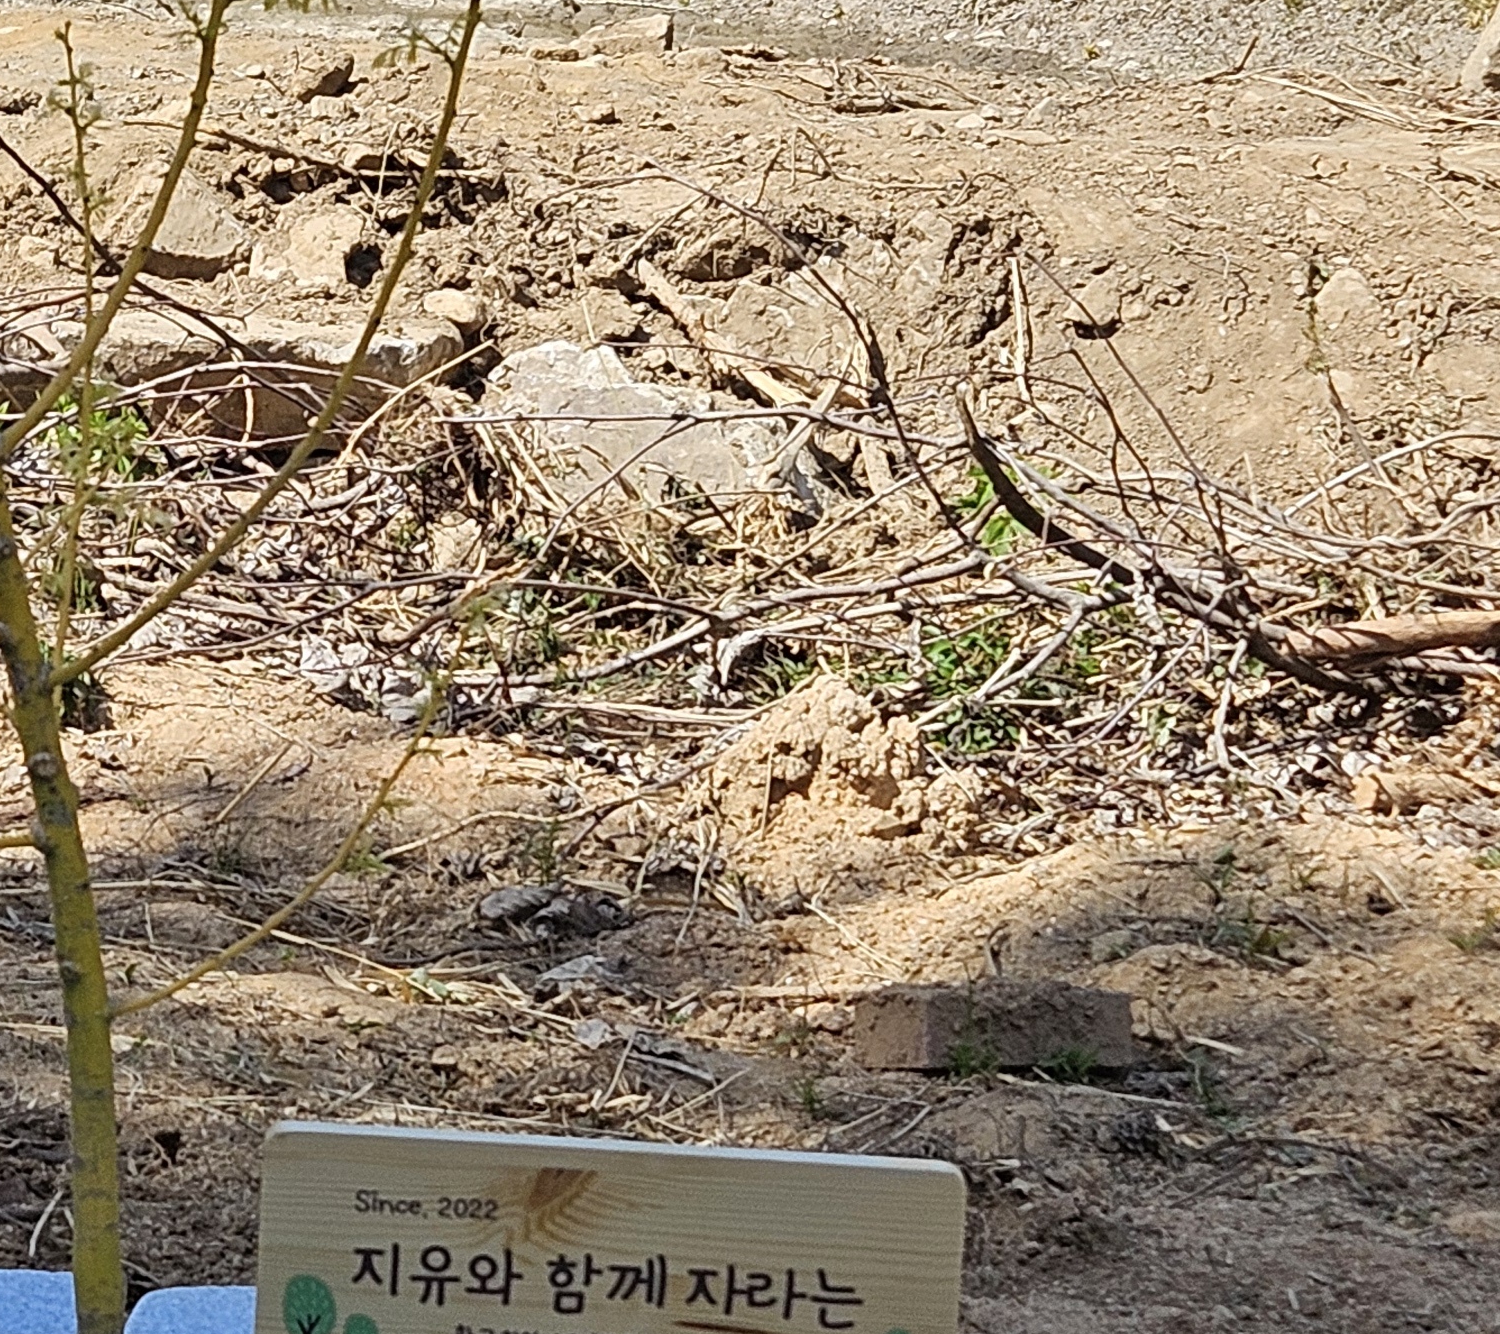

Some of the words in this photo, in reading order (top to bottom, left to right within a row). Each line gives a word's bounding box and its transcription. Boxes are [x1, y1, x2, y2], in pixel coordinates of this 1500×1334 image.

[437, 1197, 499, 1221] 2022
[351, 1242, 524, 1307] 지유와
[545, 1252, 668, 1315] 함께
[684, 1263, 864, 1330] 자라는
